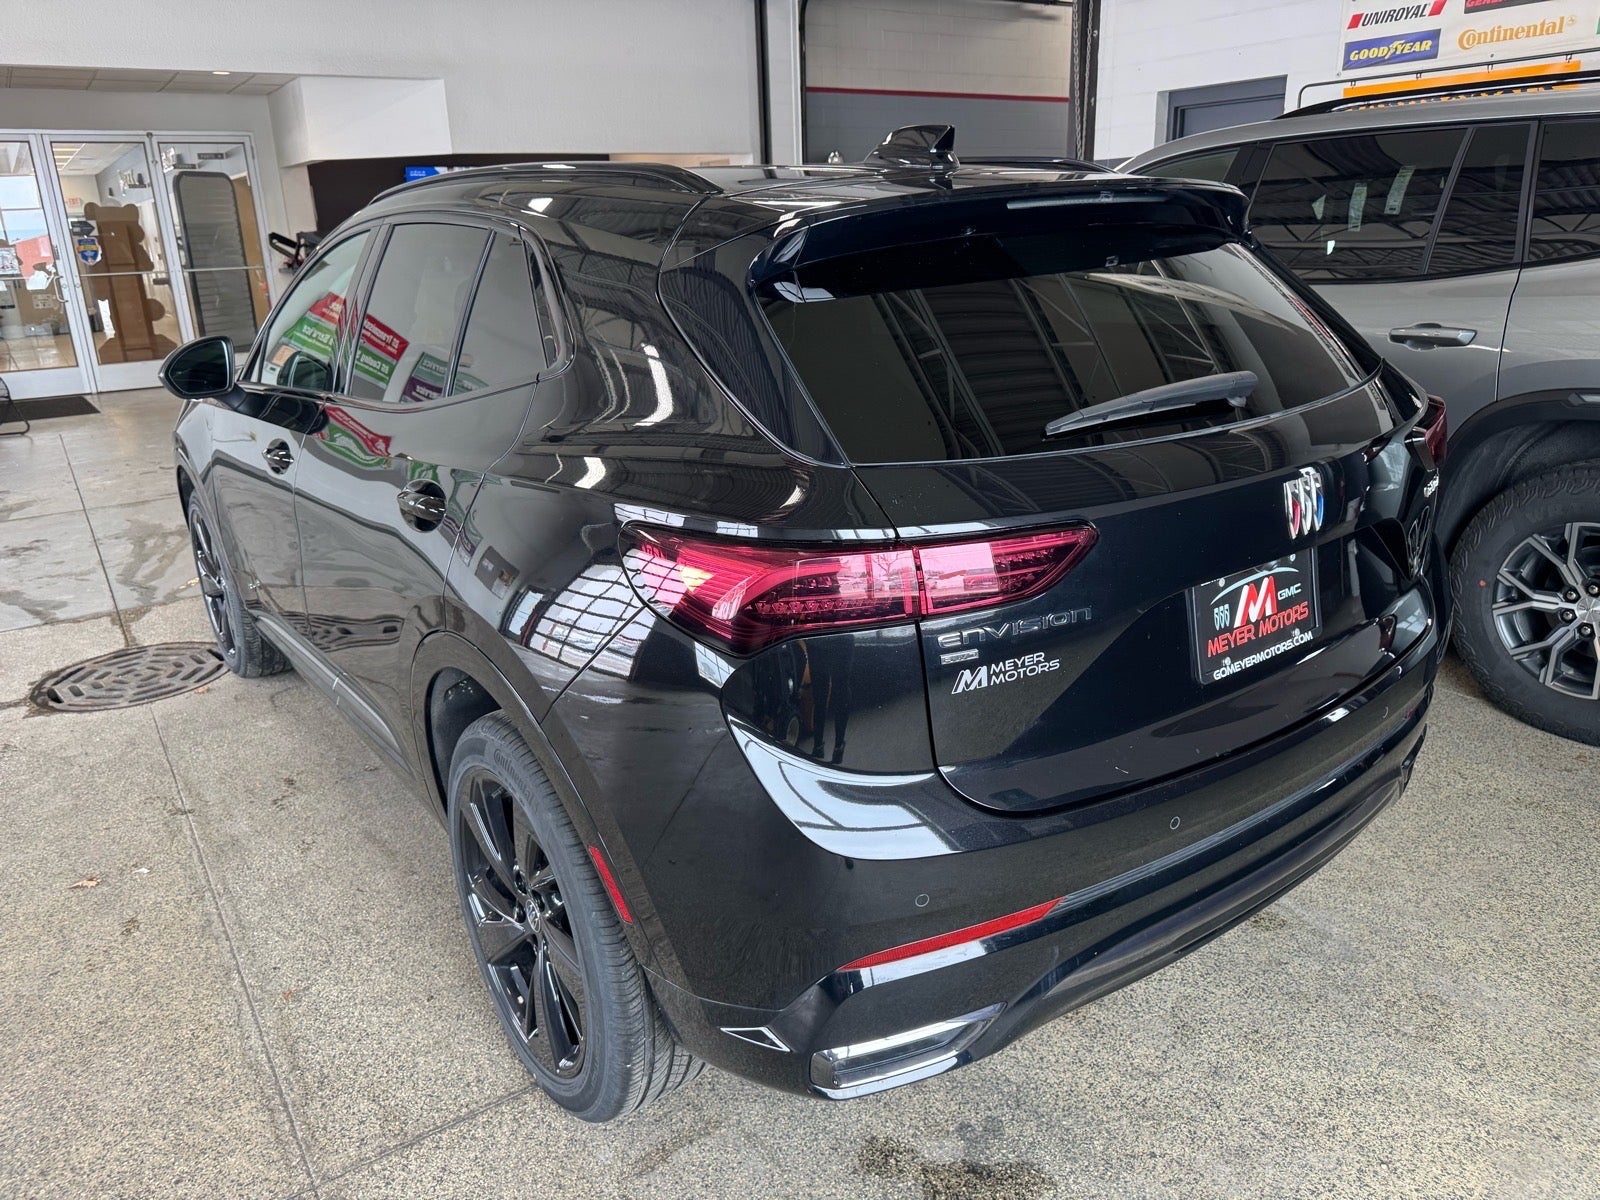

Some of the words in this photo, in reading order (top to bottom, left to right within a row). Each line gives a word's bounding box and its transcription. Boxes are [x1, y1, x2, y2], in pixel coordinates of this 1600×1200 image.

[1361, 3, 1428, 27] UNIROYAL
[1457, 15, 1566, 51] Continental
[1349, 39, 1433, 61] GOODYEAR
[1277, 583, 1302, 601] GMC
[1207, 624, 1256, 658] MEYER
[1259, 600, 1309, 638] MOTORS
[990, 652, 1045, 675] MEYER
[1213, 630, 1314, 681] GOMEYERMOTORS.COM
[990, 659, 1060, 686] MOTORS
